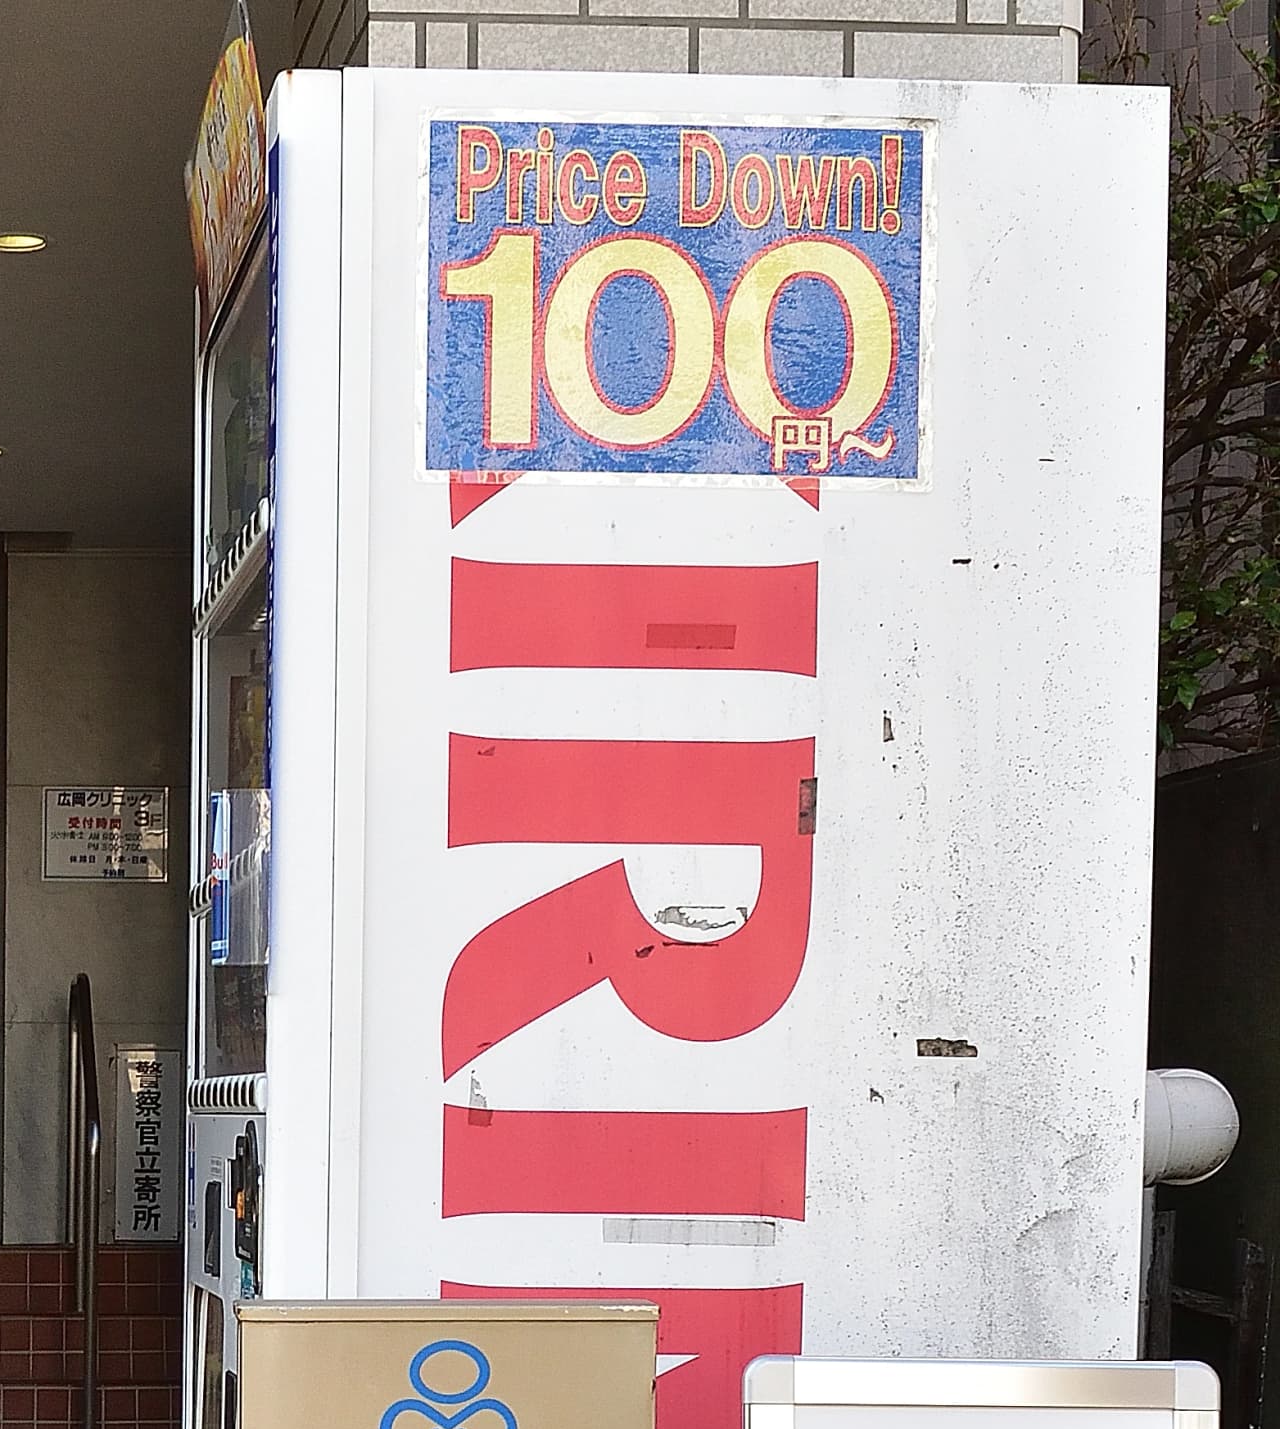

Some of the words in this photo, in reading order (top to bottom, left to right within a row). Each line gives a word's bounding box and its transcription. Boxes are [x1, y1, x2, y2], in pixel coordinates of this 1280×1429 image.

[456, 125, 648, 227] Price
[678, 128, 904, 236] Down!
[57, 791, 153, 808] 広岡クリニック
[68, 817, 122, 830] 受付時間
[134, 810, 162, 828] 3F
[132, 1060, 163, 1232] 警察官立寄所
